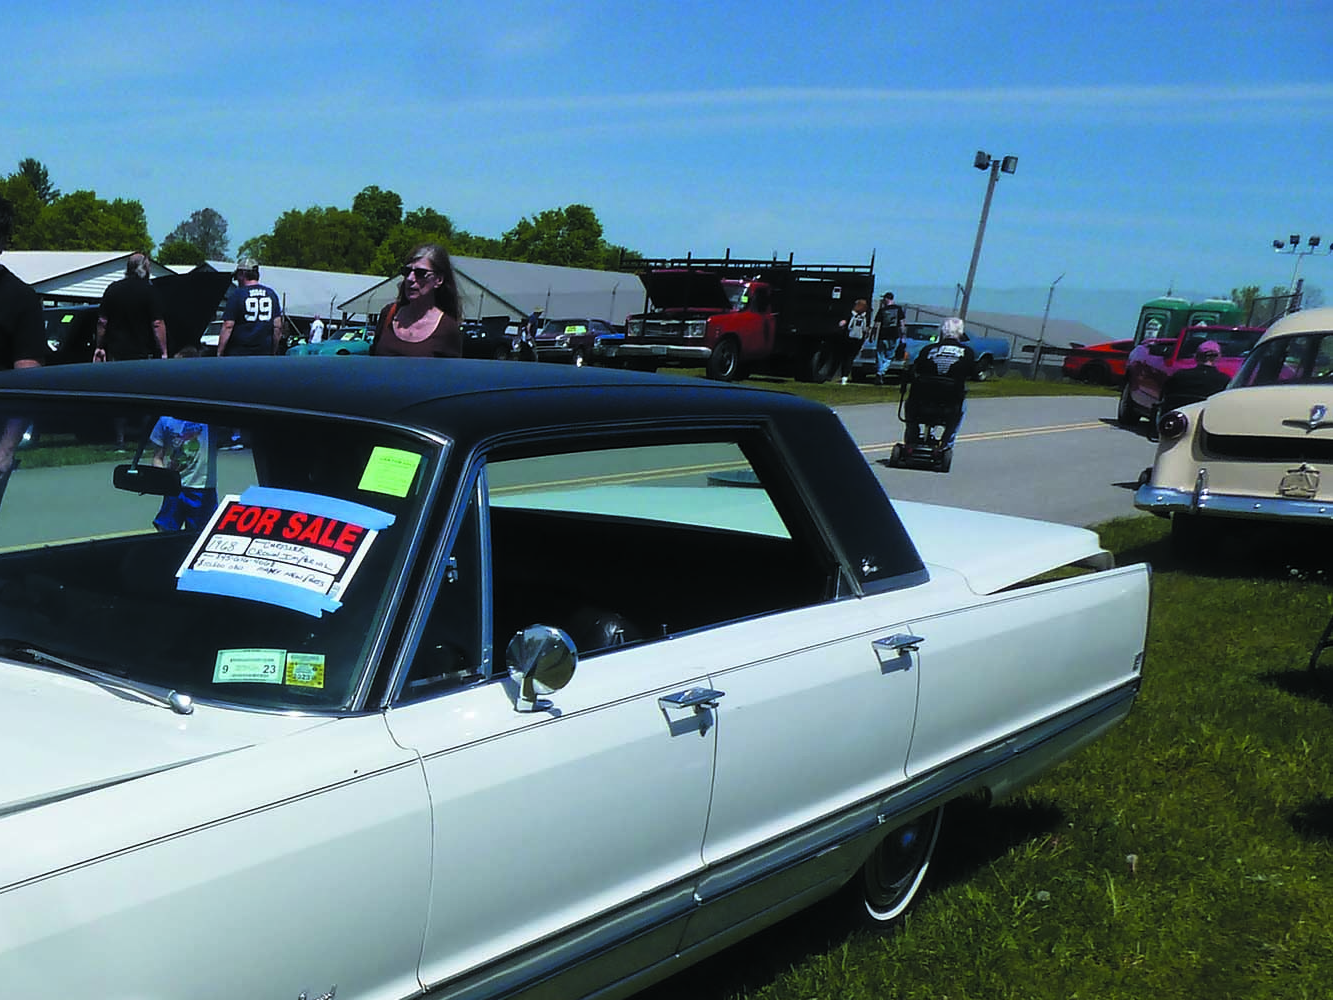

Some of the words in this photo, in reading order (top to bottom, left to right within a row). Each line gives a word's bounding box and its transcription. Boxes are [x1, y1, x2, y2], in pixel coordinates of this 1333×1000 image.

[244, 297, 272, 321] 99
[217, 504, 282, 535] FOR
[282, 511, 364, 554] SALE
[206, 540, 239, 552] 1968
[222, 665, 229, 674] 9
[263, 664, 277, 674] 23
